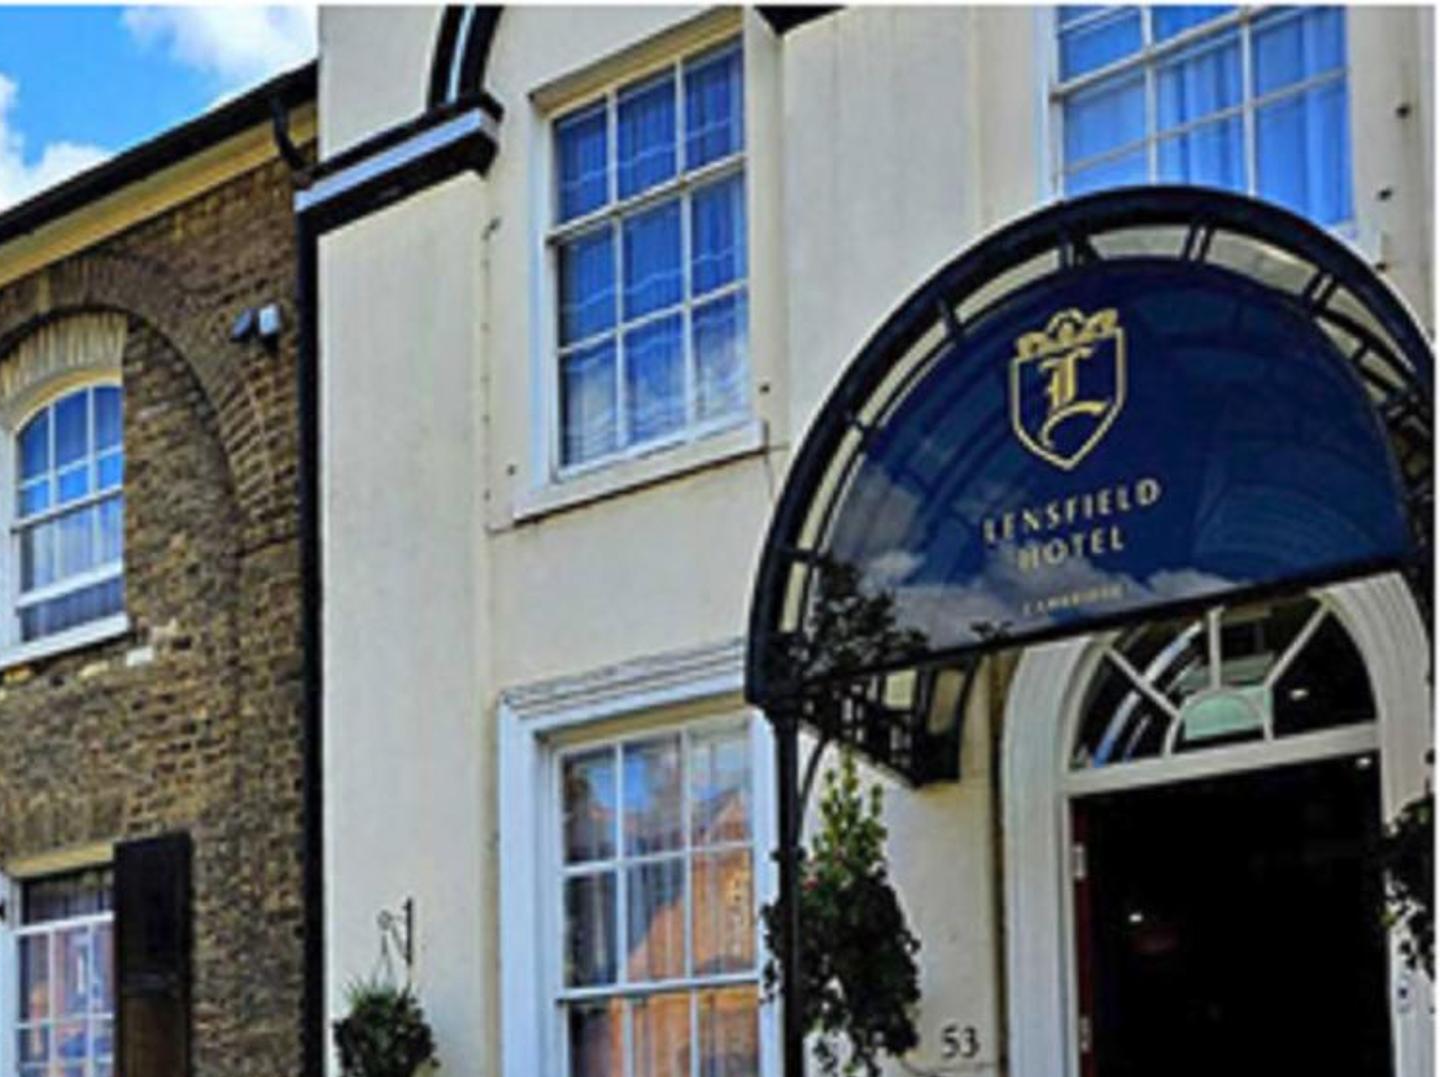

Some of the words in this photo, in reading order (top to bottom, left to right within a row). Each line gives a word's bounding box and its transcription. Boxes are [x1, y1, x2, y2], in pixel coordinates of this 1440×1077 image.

[982, 478, 1160, 544] LENSFIELD
[1017, 524, 1124, 572] HOTEL
[942, 1025, 980, 1058] 53
